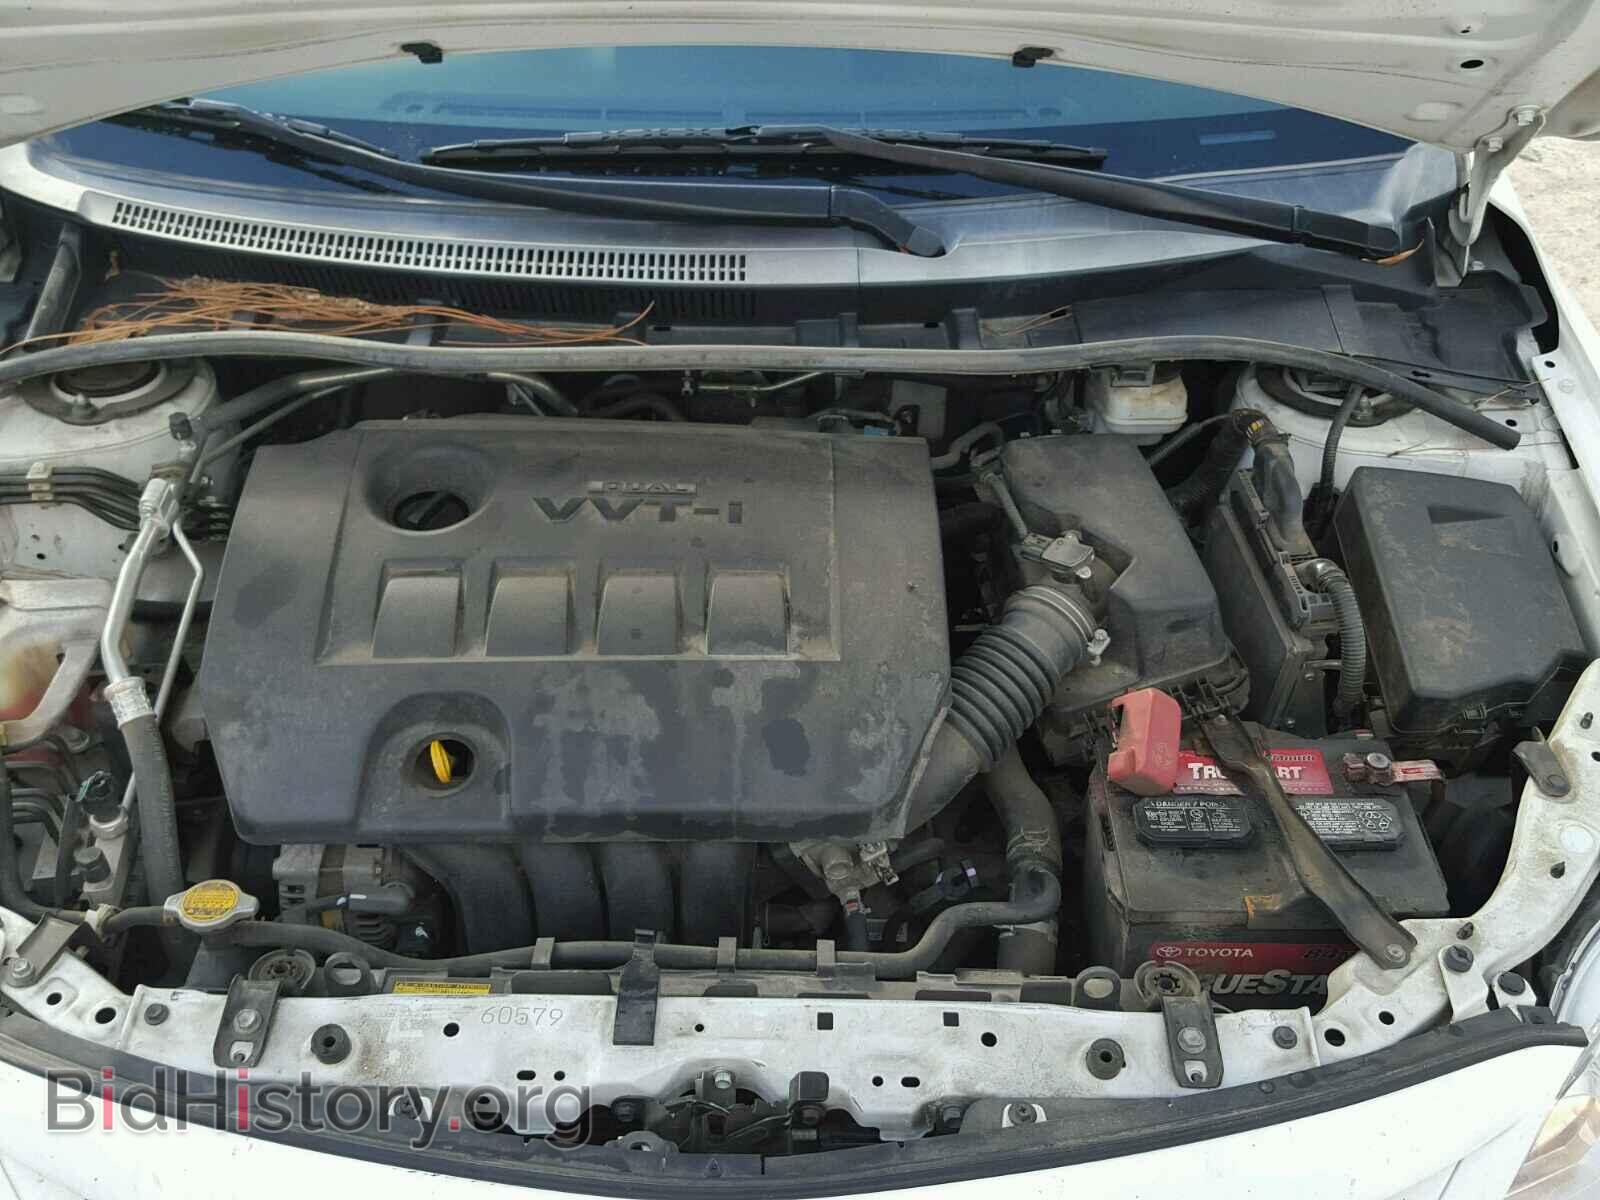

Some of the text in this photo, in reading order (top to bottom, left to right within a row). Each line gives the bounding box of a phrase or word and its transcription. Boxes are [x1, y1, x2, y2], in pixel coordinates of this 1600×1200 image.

[602, 481, 692, 494] DUAL
[1186, 947, 1254, 958] TOYOTA
[480, 1006, 564, 1026] 60579
